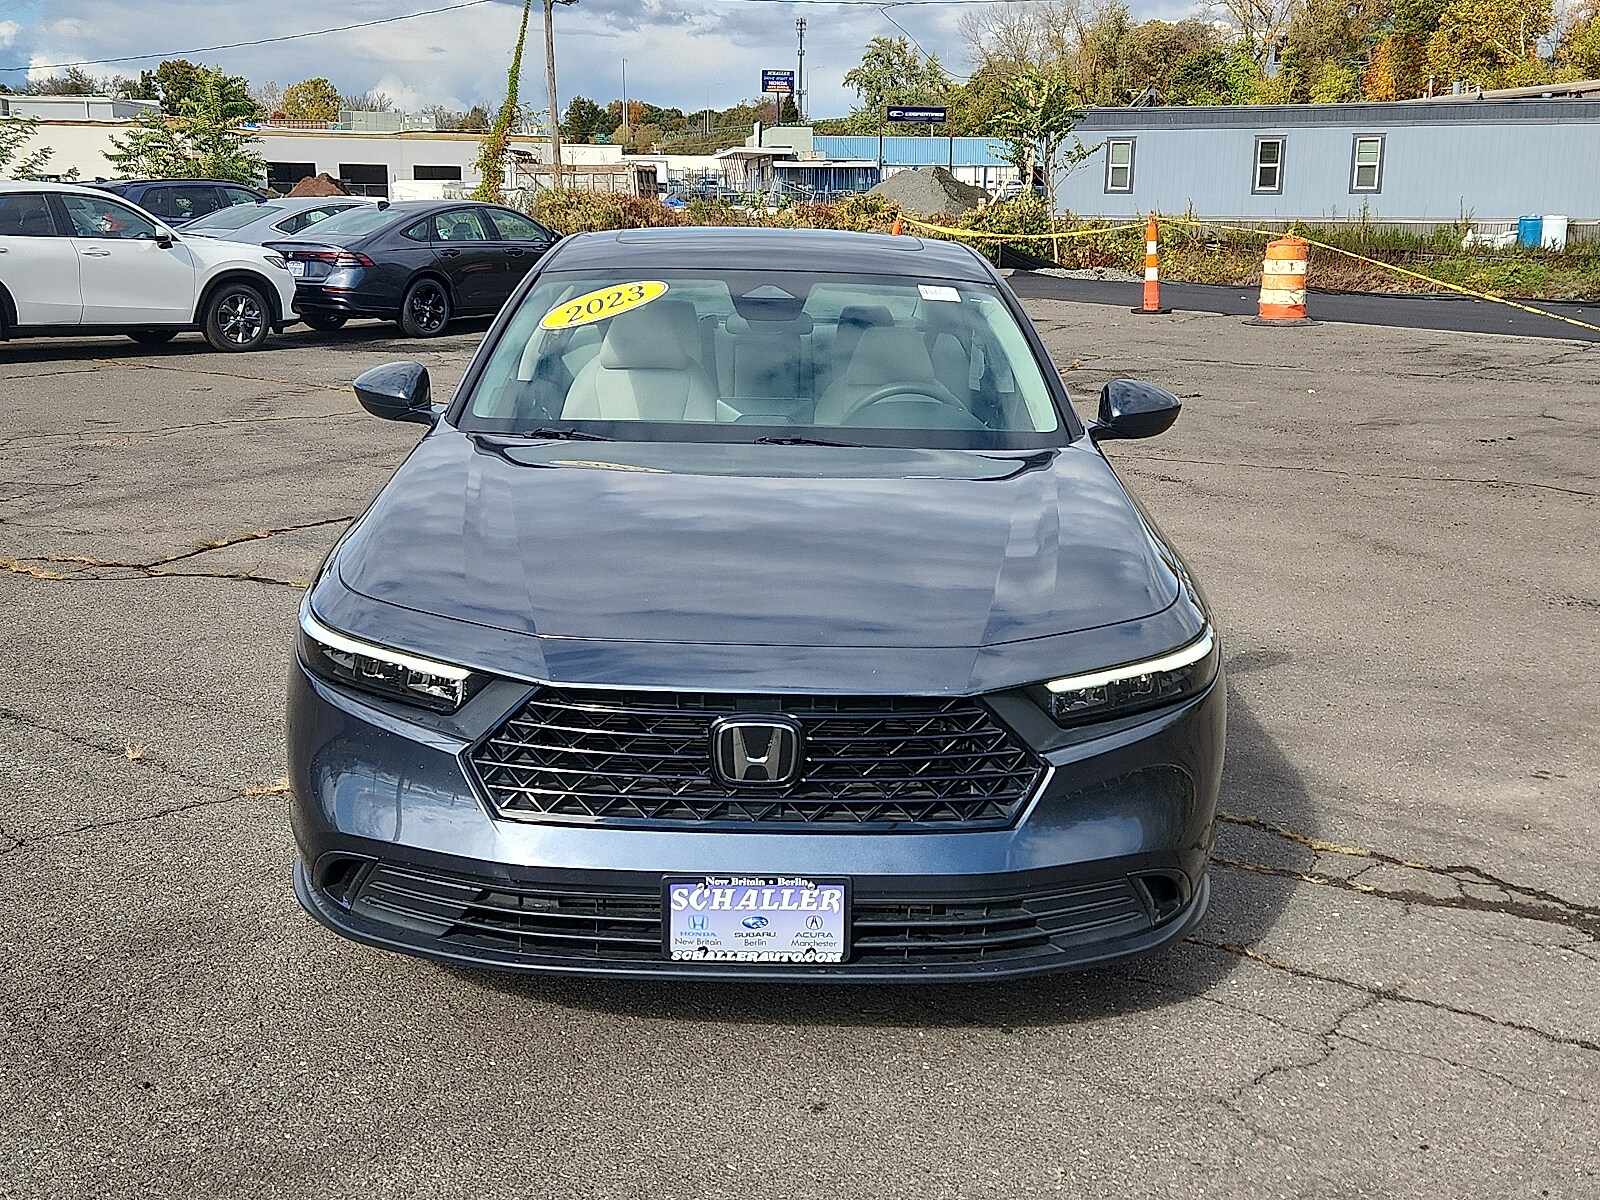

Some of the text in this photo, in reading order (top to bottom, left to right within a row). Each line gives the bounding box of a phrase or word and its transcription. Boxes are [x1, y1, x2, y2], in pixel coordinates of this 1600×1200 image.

[566, 285, 645, 323] 2023
[705, 876, 808, 887] New Britain Berlin
[671, 887, 843, 914] SCHALLER
[794, 931, 834, 939] ACURA
[674, 937, 722, 947] New Britain
[744, 938, 767, 947] Berlin
[790, 939, 837, 948] Manchester
[670, 950, 843, 963] SCHALLERAUTO.COM
